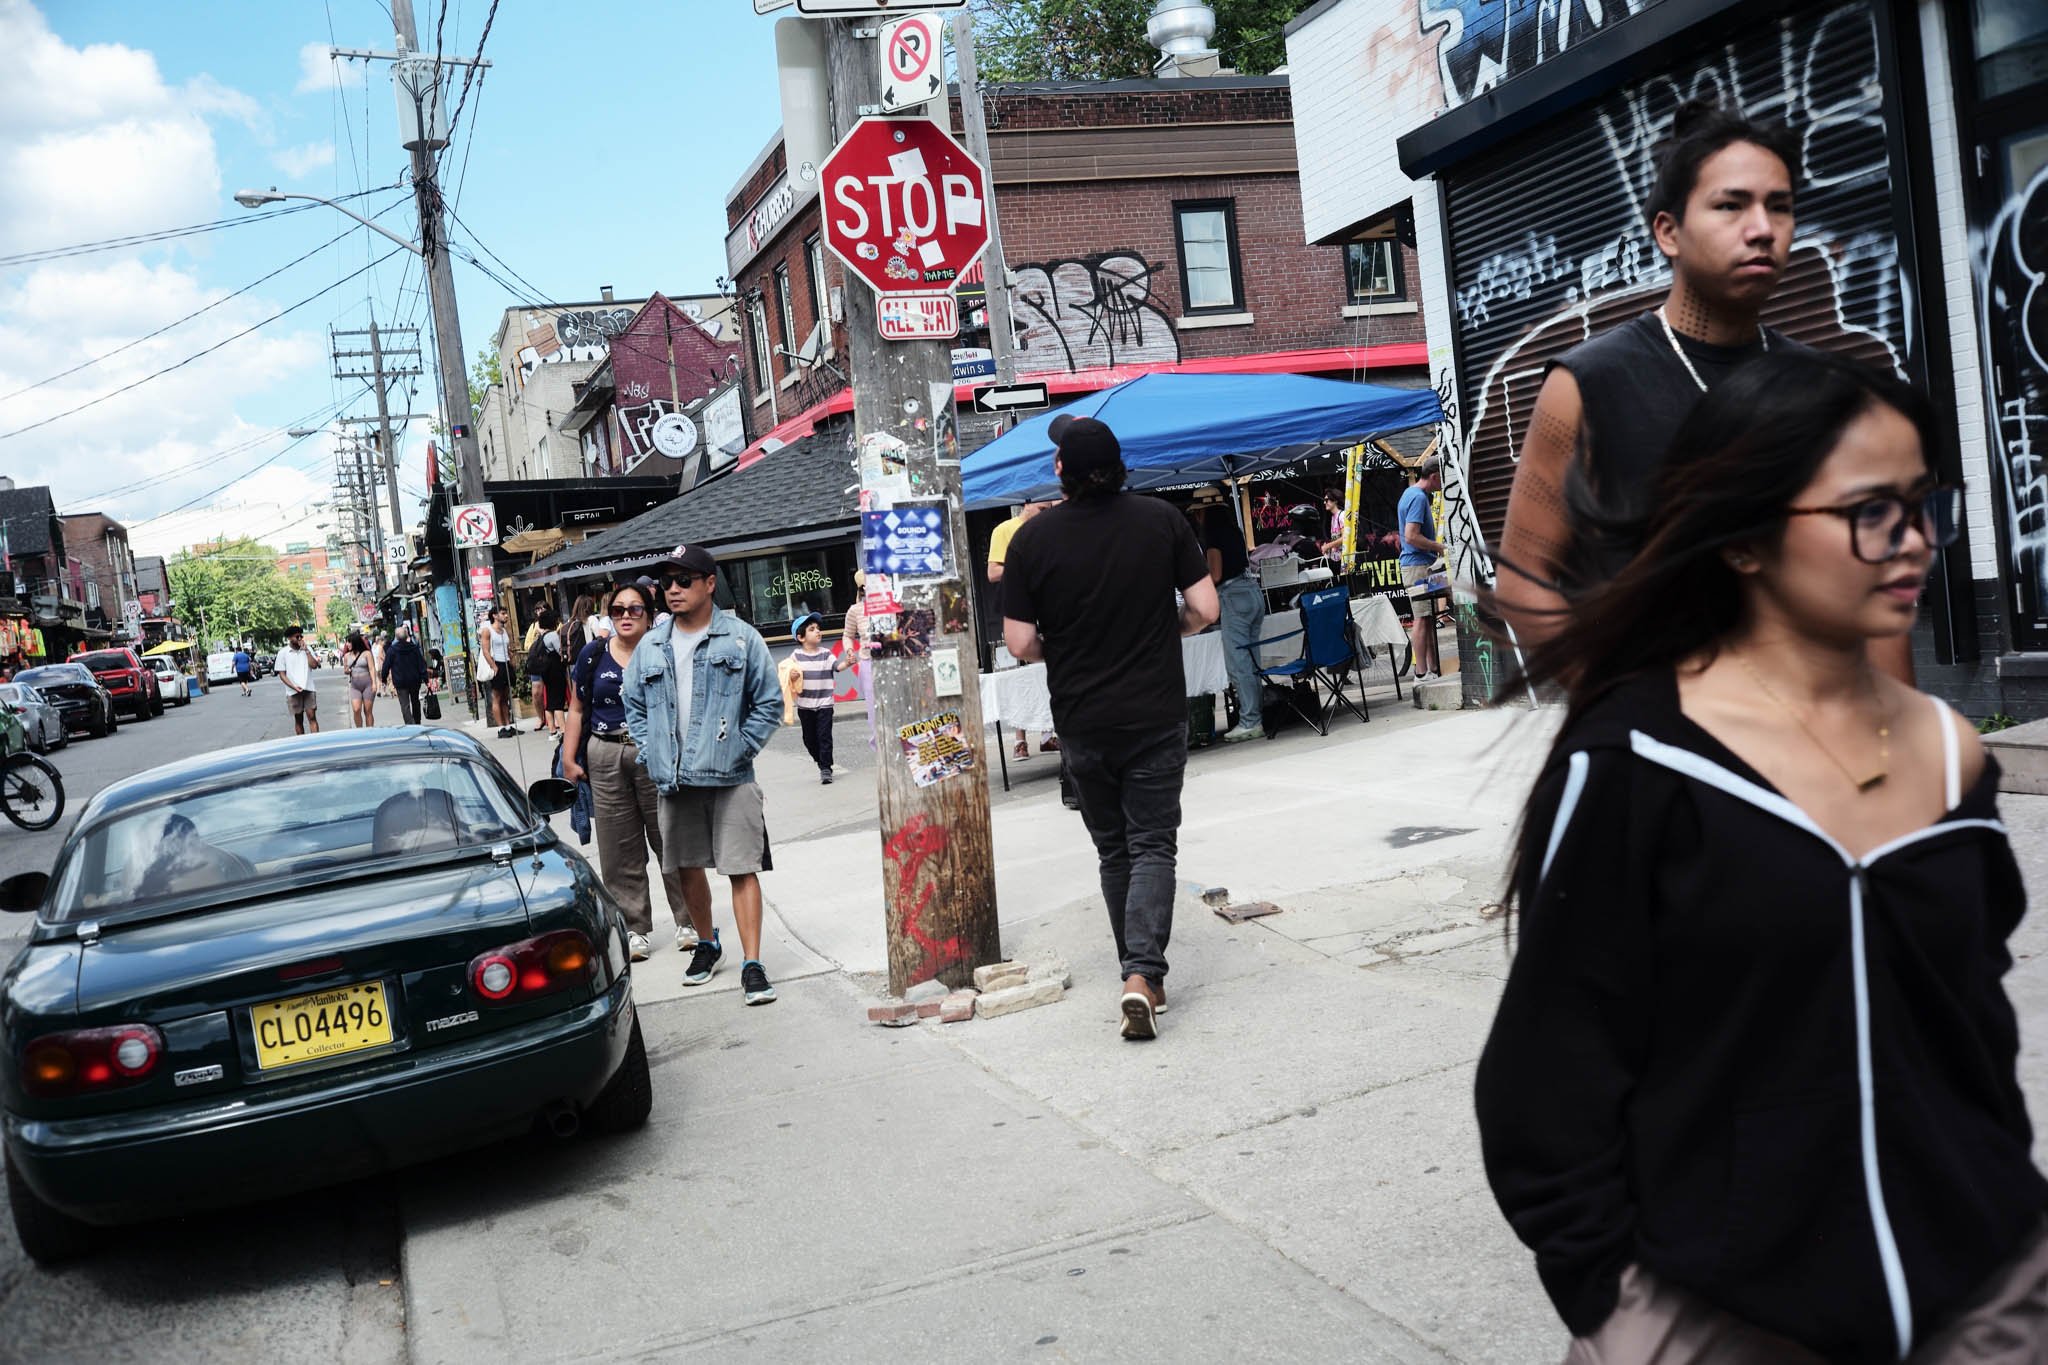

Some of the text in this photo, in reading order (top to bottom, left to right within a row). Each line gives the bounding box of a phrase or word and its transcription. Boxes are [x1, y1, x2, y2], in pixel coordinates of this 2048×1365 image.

[755, 184, 793, 241] CHURROS
[834, 174, 976, 240] STOP
[920, 300, 951, 332] WAY
[952, 363, 985, 377] dwin St
[391, 545, 406, 558] 30
[773, 569, 821, 586] CHURROS
[764, 577, 833, 598] CALENTITOS
[915, 717, 943, 735] POINTS
[309, 991, 349, 1007] Manitoba
[260, 998, 384, 1049] CL04496
[306, 1041, 346, 1056] Collector
